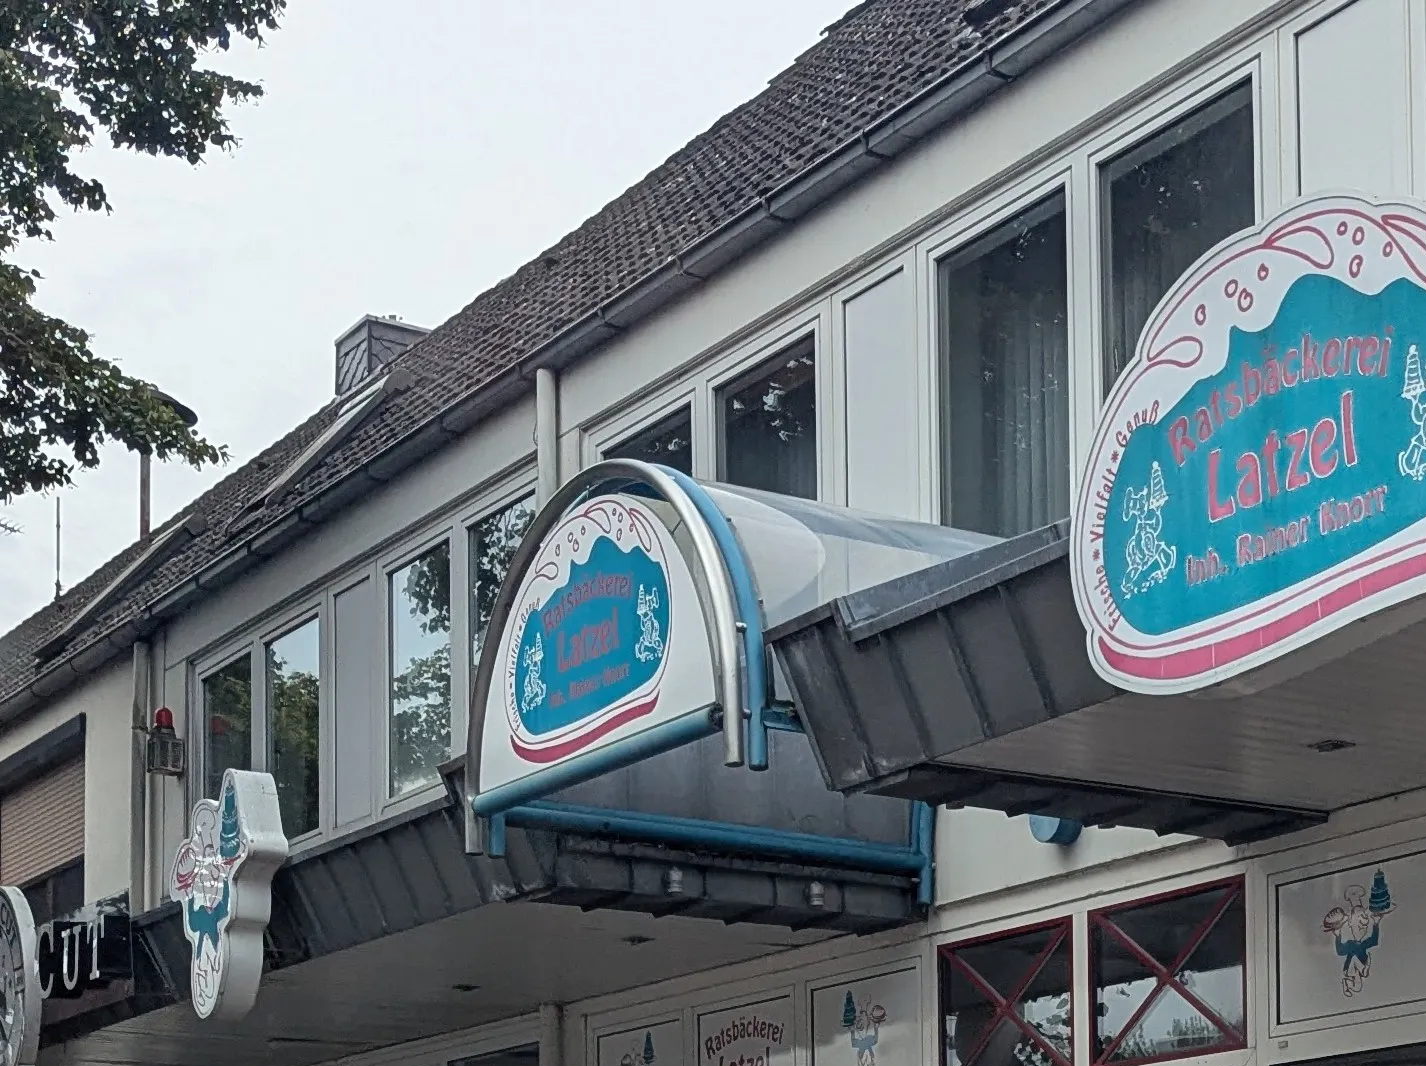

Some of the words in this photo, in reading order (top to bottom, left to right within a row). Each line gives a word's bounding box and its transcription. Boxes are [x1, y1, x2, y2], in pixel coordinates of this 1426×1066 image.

[1115, 400, 1160, 448] Genuß
[1168, 325, 1394, 467] Ratsbäckerei
[1208, 390, 1358, 523] Latzel
[1090, 468, 1118, 544] Vielfalt
[1186, 548, 1228, 586] Inh.
[1236, 515, 1310, 567] Rainer
[1319, 485, 1388, 535] Knorr
[1094, 565, 1122, 632] Frische
[557, 605, 620, 673] Latzel
[36, 913, 106, 1000] CUT
[705, 1016, 785, 1060] Ratsbäckerei
